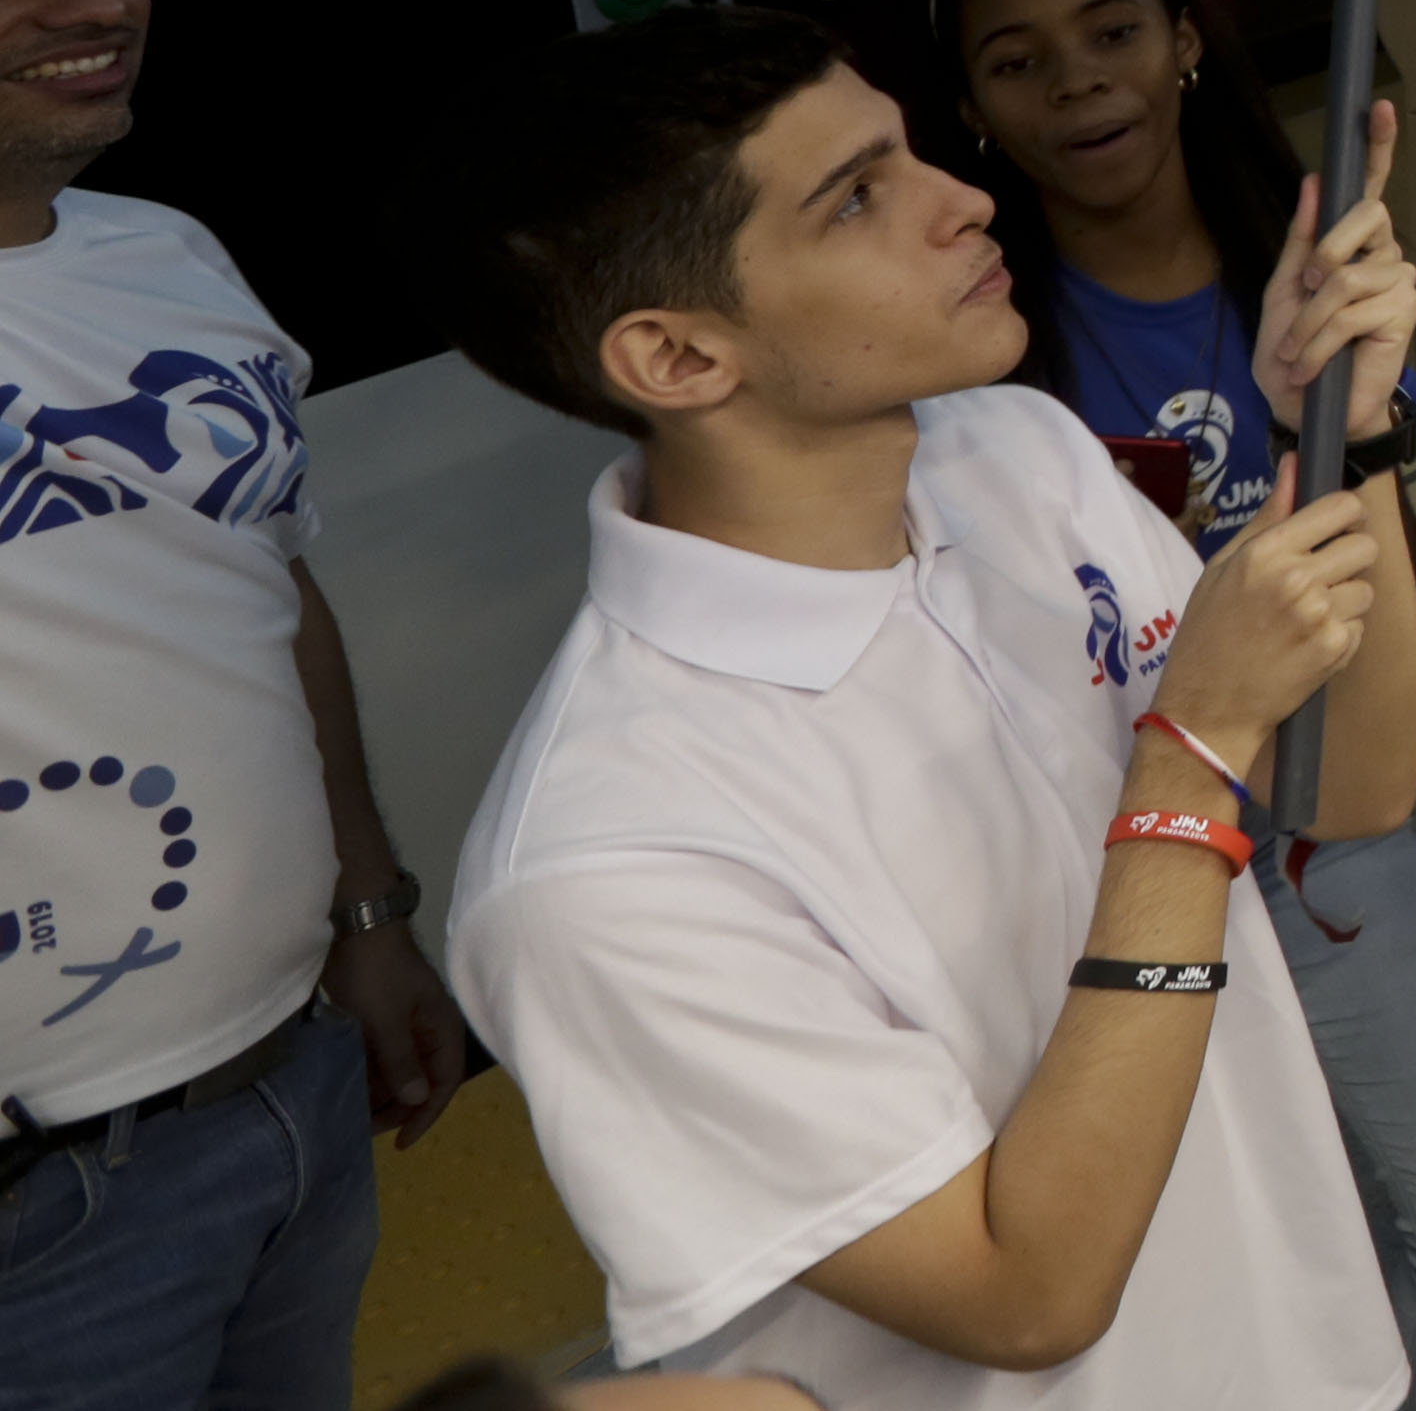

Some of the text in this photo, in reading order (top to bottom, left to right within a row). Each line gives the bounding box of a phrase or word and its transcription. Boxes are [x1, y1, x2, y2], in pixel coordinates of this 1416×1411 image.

[1169, 814, 1209, 833] JMJ
[27, 900, 57, 955] 2019
[1176, 965, 1211, 982] JMJ
